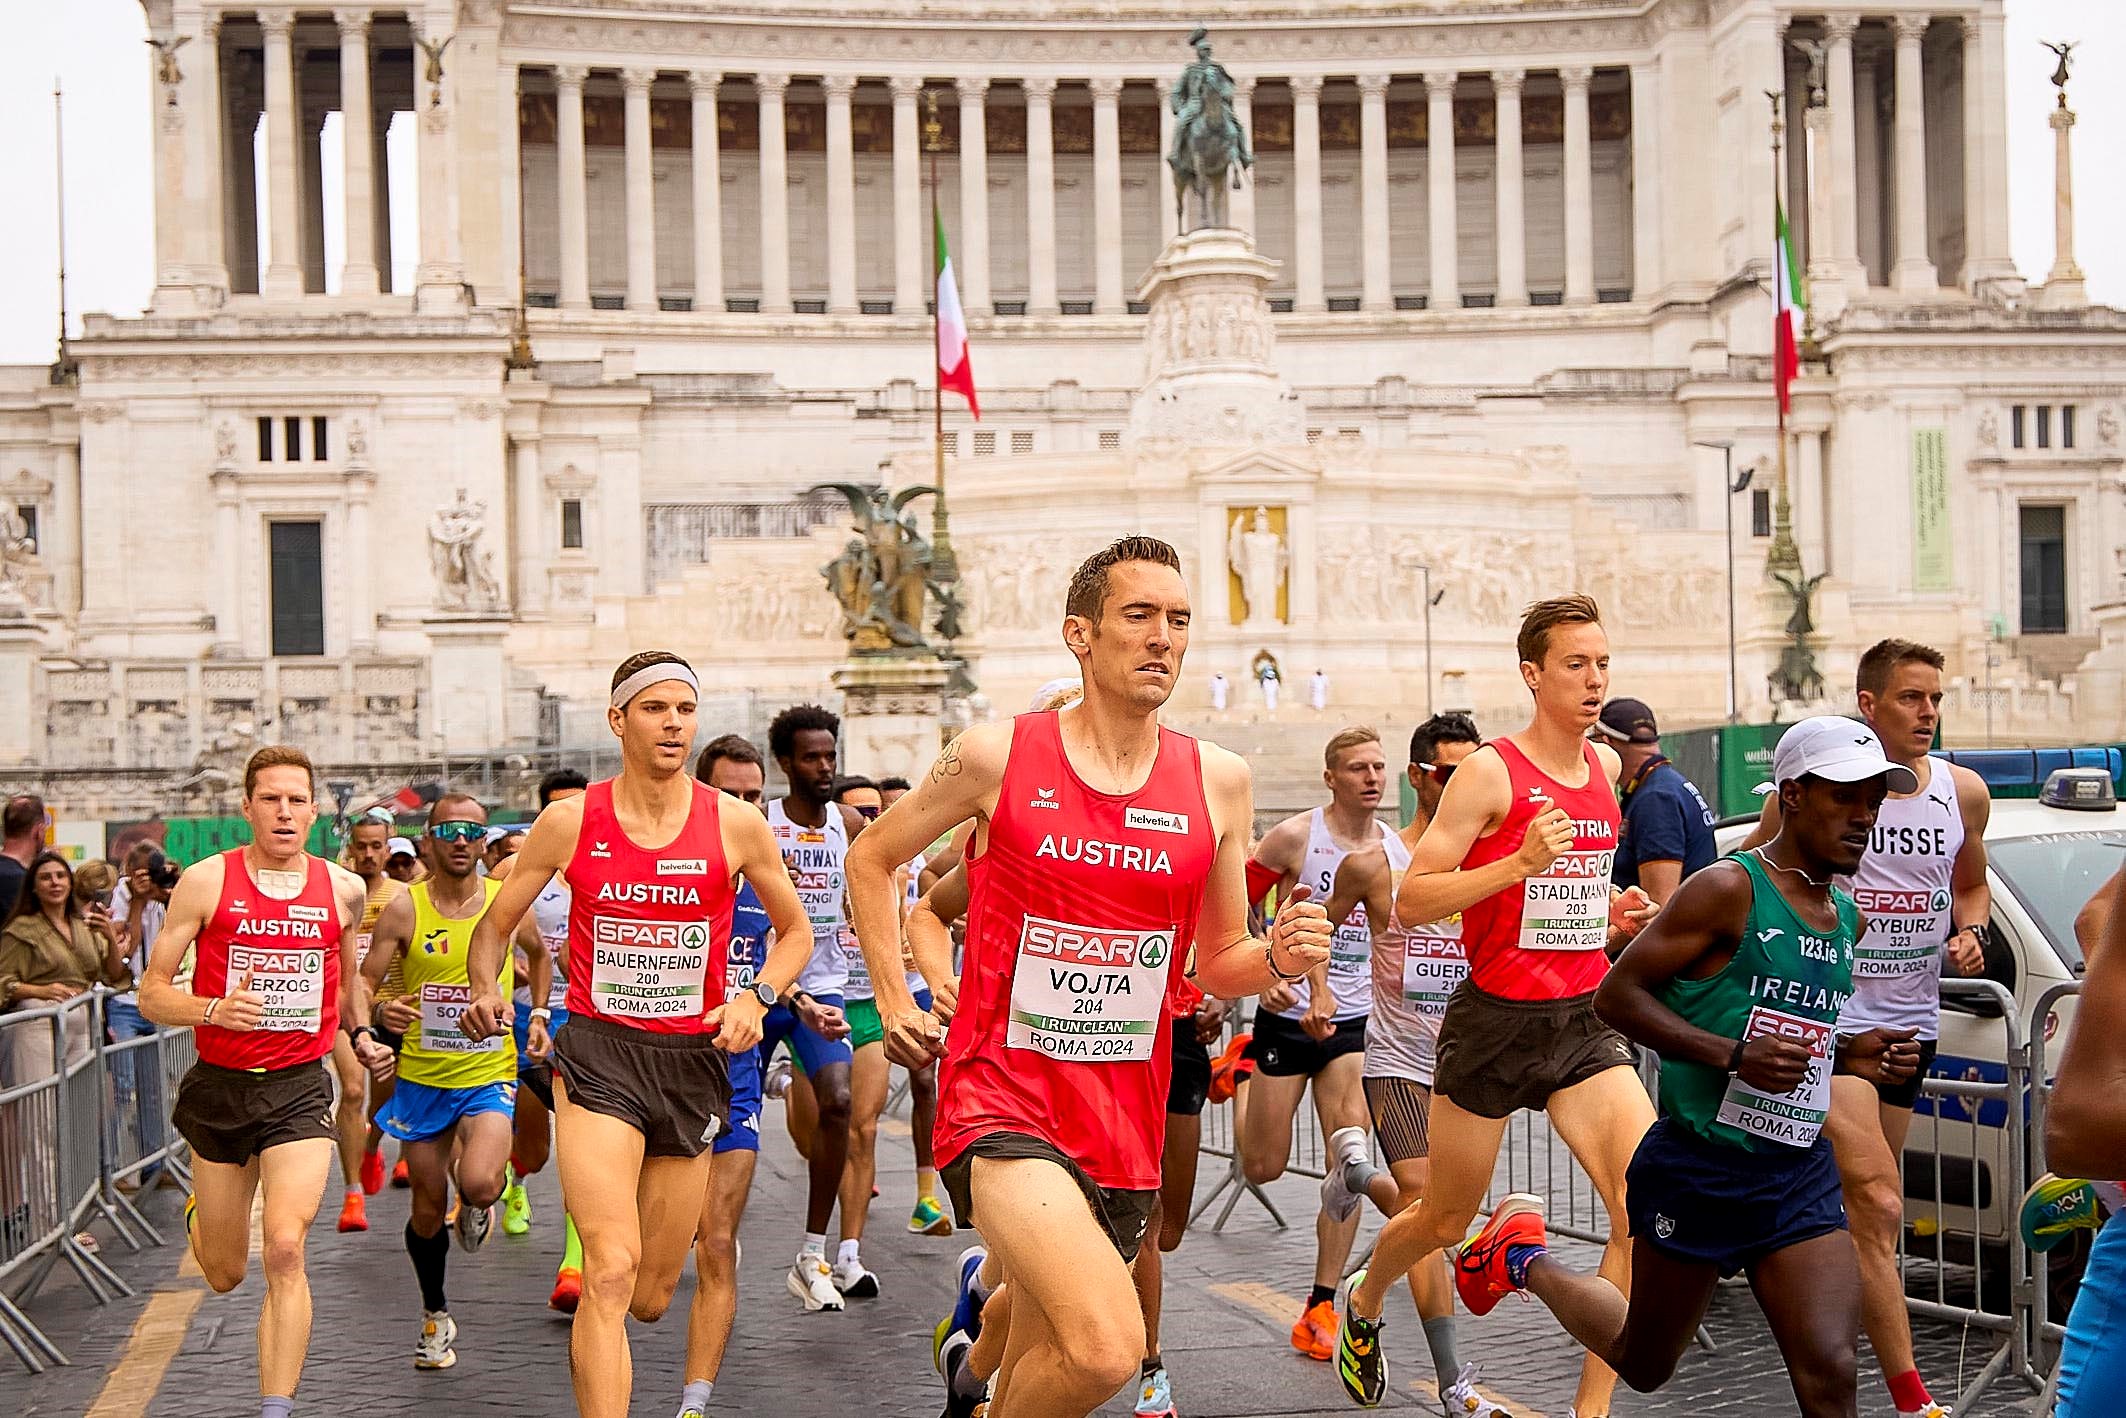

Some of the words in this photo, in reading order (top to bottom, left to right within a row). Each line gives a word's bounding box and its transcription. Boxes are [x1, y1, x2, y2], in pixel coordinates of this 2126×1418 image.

[1029, 798, 1060, 810] erima
[1130, 813, 1170, 828] helvetia
[1571, 819, 1612, 838] STRIA
[1035, 833, 1173, 875] AUSTRIA
[660, 862, 692, 871] helvetia
[1540, 856, 1598, 876] PAR
[597, 882, 701, 905] AUSTRIA
[803, 905, 817, 914] 10
[1565, 903, 1587, 915] 203
[1855, 893, 1928, 911] SPAR
[236, 918, 322, 939] AUSTRIA
[1549, 919, 1571, 929] RUN
[1866, 917, 1936, 934] KYBURZ
[598, 922, 677, 946] SPAR
[1535, 932, 1578, 945] ROMA
[1889, 936, 1911, 947] 323
[1025, 926, 1135, 963] SPAR
[1410, 938, 1466, 957] SPA
[1798, 935, 1838, 964] 123.ie
[232, 951, 300, 972] SPAR
[597, 949, 702, 970] BAUERNFEIND
[1873, 950, 1895, 958] RUN
[1859, 962, 1900, 974] ROMA
[1903, 960, 1928, 973] 2024
[239, 976, 310, 992] ERZOG
[636, 972, 660, 985] 200
[1049, 967, 1132, 995] VOJTA
[1441, 980, 1458, 991] 21
[423, 986, 471, 1001] SPA
[620, 985, 643, 995] RUN
[644, 987, 677, 997] CLEAN
[264, 995, 284, 1005] 201
[607, 998, 651, 1013] ROMA
[654, 999, 687, 1012] 2024
[1072, 998, 1103, 1015] 204
[1415, 1003, 1445, 1015] ROM
[281, 1020, 308, 1028] 2024
[1041, 1018, 1047, 1029] I
[1048, 1019, 1082, 1032] RUN
[1084, 1021, 1124, 1033] CLEAN
[432, 1040, 465, 1049] ROMA
[1030, 1032, 1088, 1056] ROMA
[1091, 1039, 1134, 1055] 2024
[1761, 1099, 1790, 1116] RUN
[1738, 1110, 1794, 1140] ROMA
